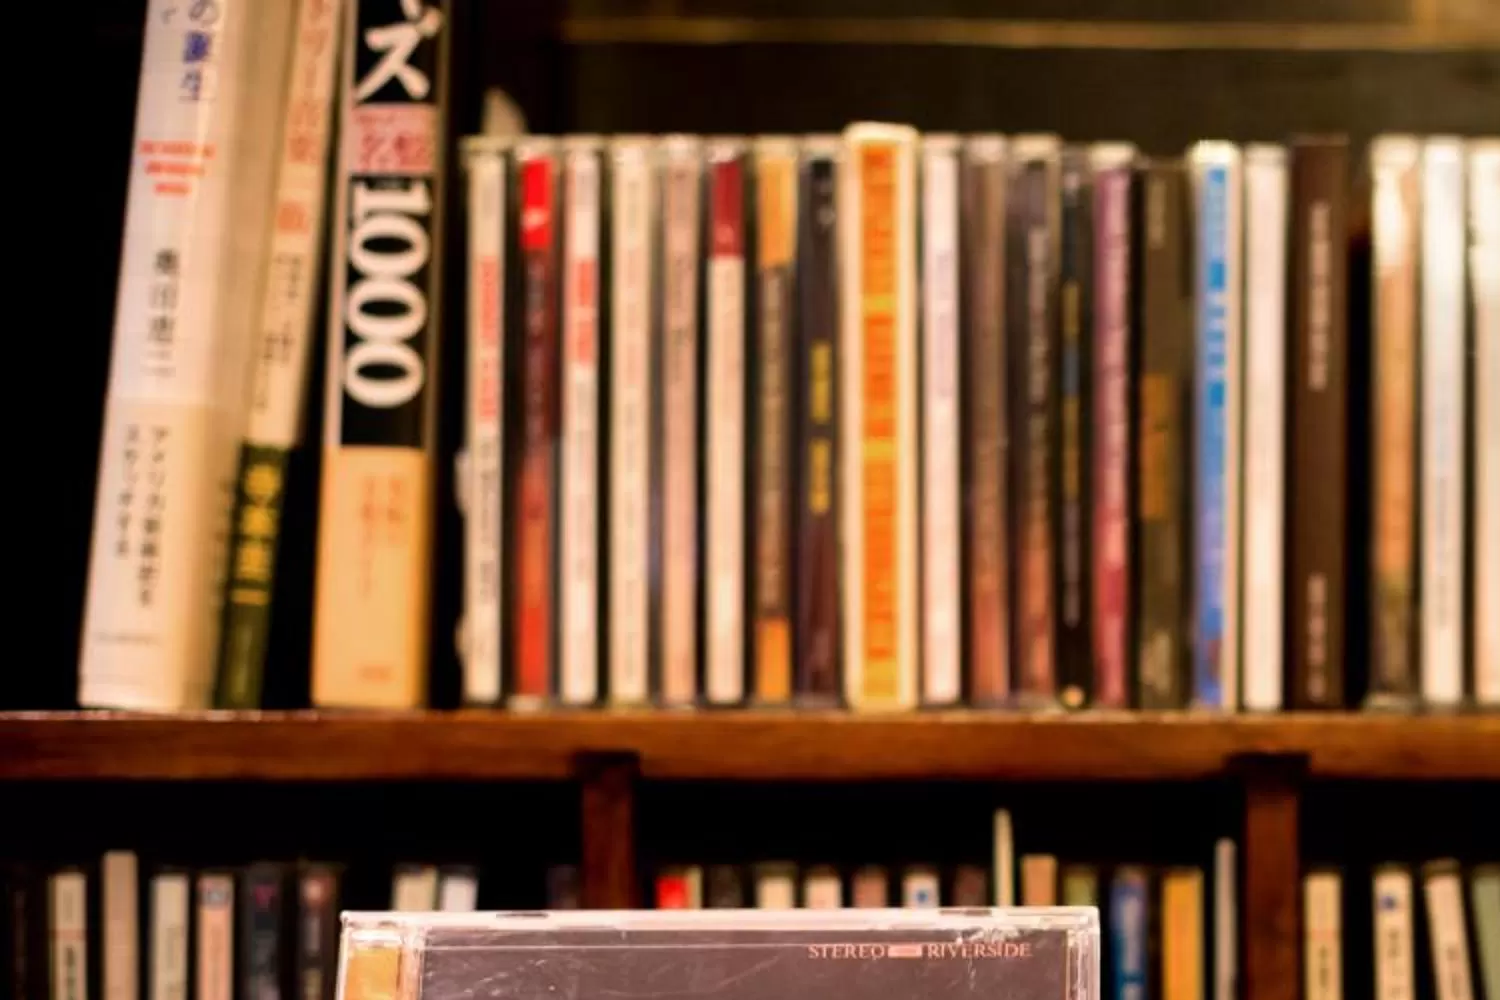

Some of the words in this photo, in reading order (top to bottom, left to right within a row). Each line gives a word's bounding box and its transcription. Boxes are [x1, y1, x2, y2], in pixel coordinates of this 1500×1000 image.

[179, 0, 221, 104] の生
[344, 179, 432, 409] 1000
[808, 943, 885, 959] STEREO
[927, 942, 1033, 958] RIVERSIDE
